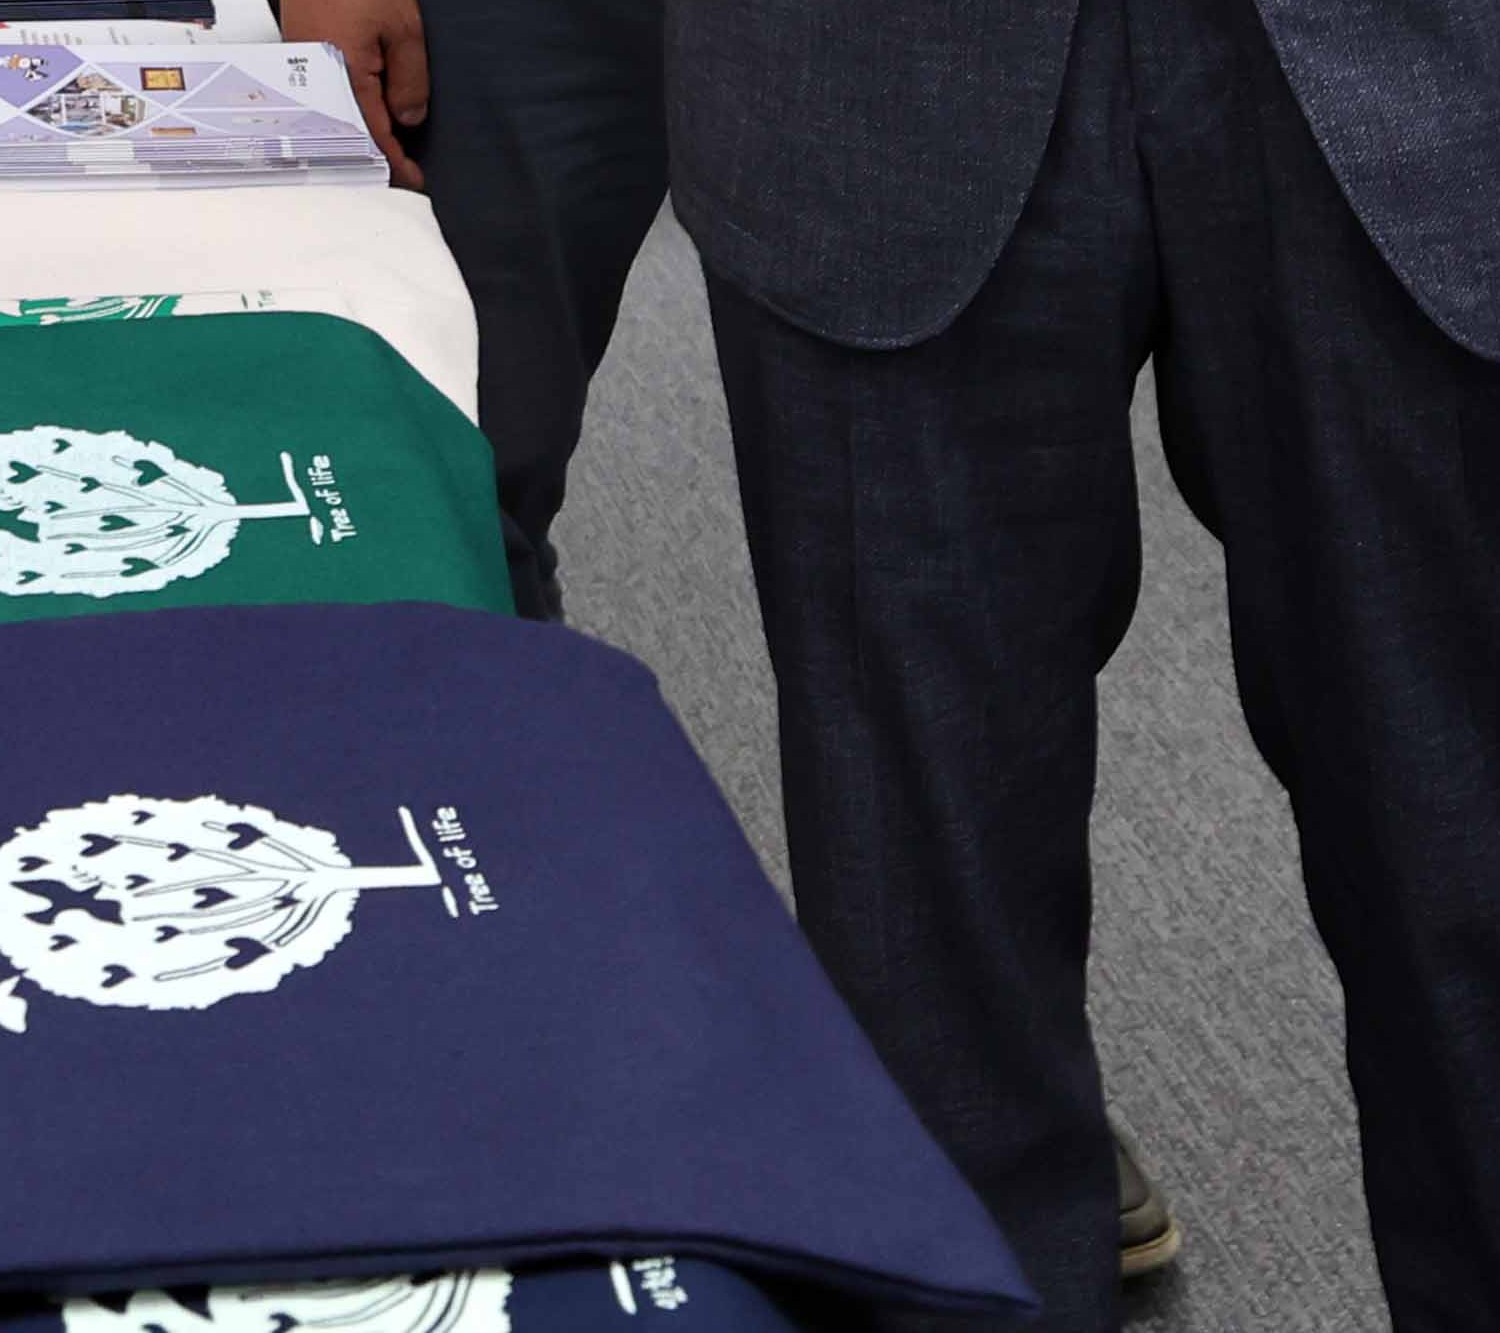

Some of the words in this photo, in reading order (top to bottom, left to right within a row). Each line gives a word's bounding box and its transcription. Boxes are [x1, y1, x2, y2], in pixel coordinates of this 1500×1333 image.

[306, 454, 336, 486] life
[314, 488, 343, 506] of
[329, 507, 358, 543] Tree
[431, 805, 467, 844] life
[442, 845, 478, 870] of
[463, 872, 500, 916] Tree
